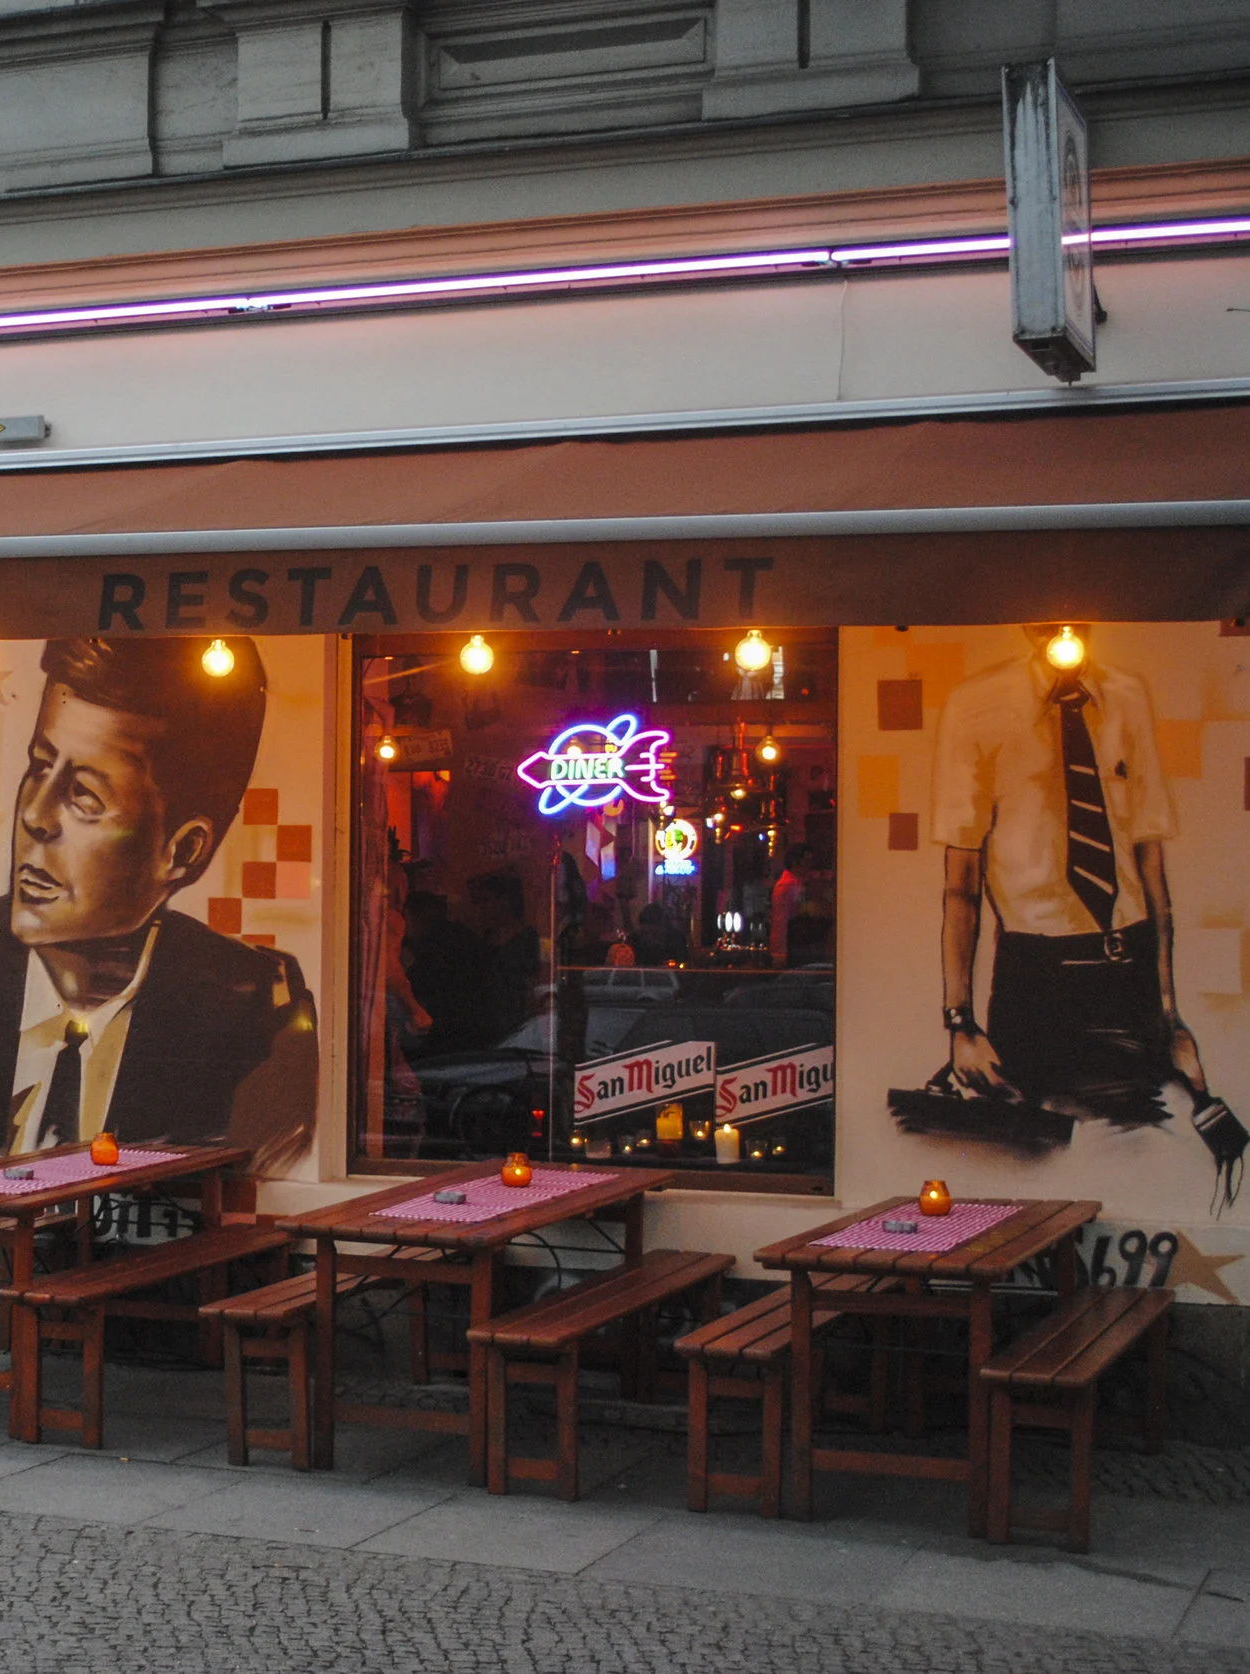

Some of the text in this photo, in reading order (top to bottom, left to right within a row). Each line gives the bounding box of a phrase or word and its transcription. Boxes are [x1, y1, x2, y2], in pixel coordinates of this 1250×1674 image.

[97, 557, 774, 631] RESTAURANT
[551, 757, 624, 780] DINER
[574, 1046, 712, 1113] San Miguel
[716, 1076, 768, 1118] San
[1075, 1227, 1178, 1288] 699
